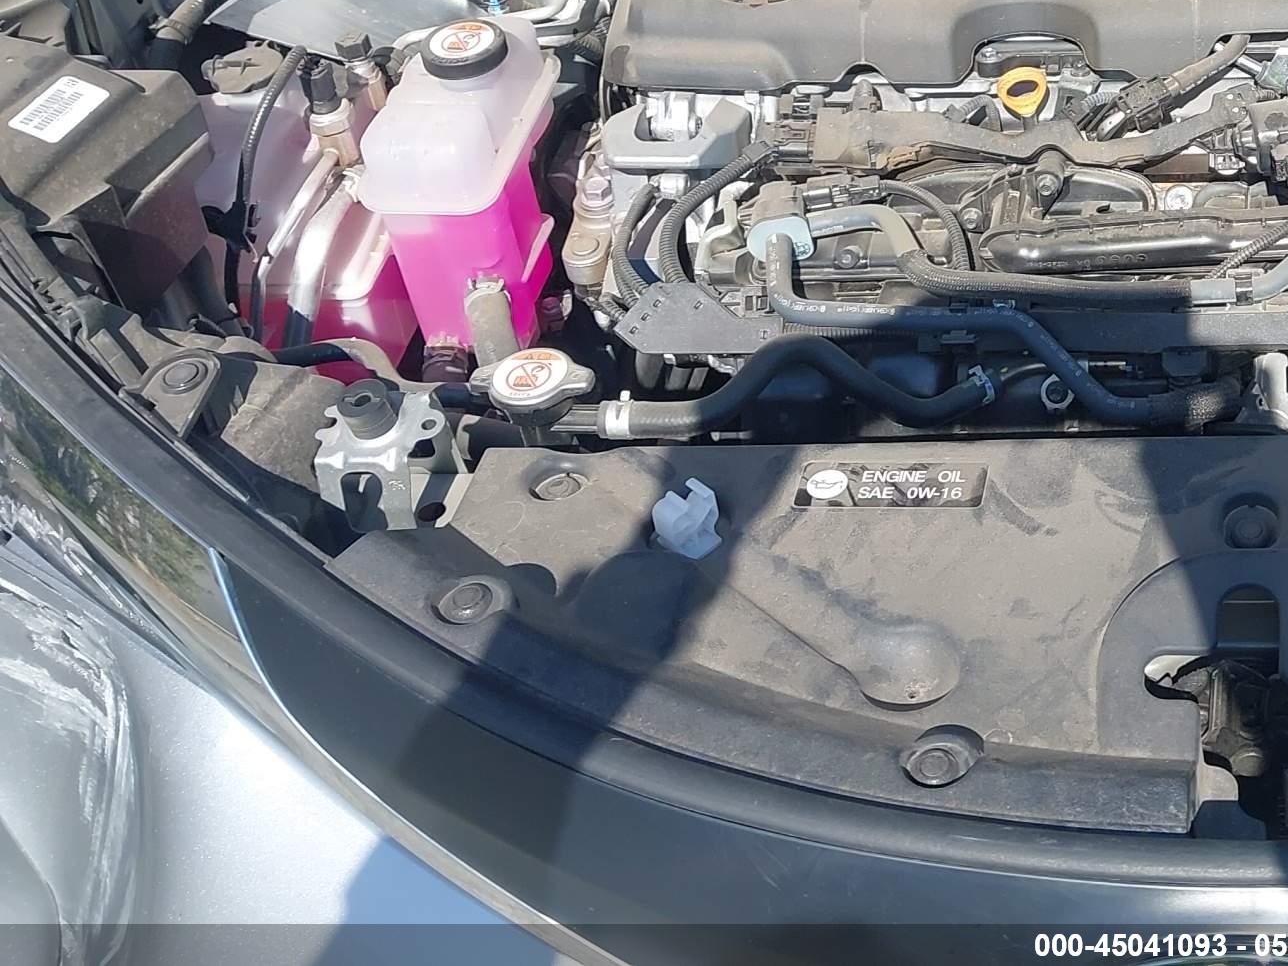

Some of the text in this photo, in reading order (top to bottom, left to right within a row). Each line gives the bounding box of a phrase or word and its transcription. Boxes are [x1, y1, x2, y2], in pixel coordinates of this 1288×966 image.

[861, 470, 966, 483] ENGINE OIL
[857, 487, 962, 499] SAE 0W-16
